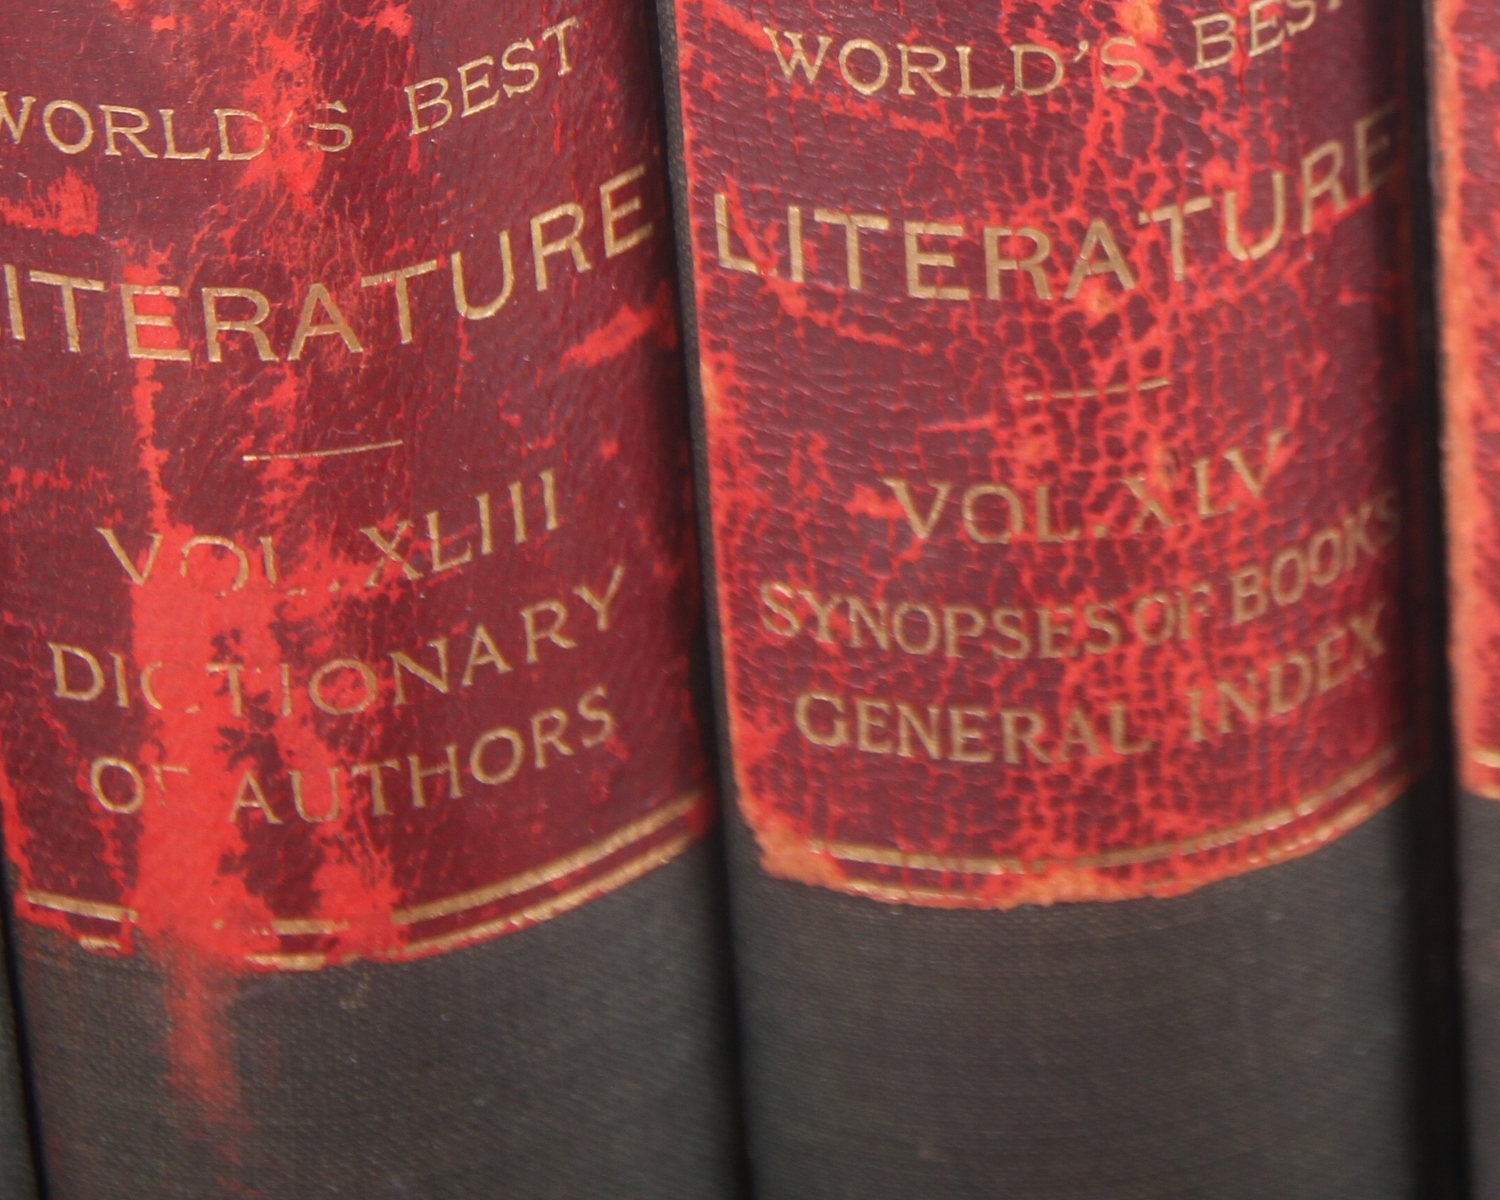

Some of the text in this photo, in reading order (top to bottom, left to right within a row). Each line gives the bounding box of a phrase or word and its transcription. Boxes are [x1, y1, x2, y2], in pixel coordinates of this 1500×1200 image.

[405, 18, 579, 138] BEST
[763, 27, 1144, 98] WORLD'S
[3, 164, 653, 362] ITERATURE
[714, 105, 1398, 301] LITERATURE
[359, 468, 558, 588] XLIII
[884, 478, 1108, 544] VOL.
[758, 582, 1121, 660] SYNOPSES
[1134, 582, 1213, 645] OF
[794, 600, 1385, 765] GENERAL INDEX
[228, 686, 615, 825] AUTHORS
